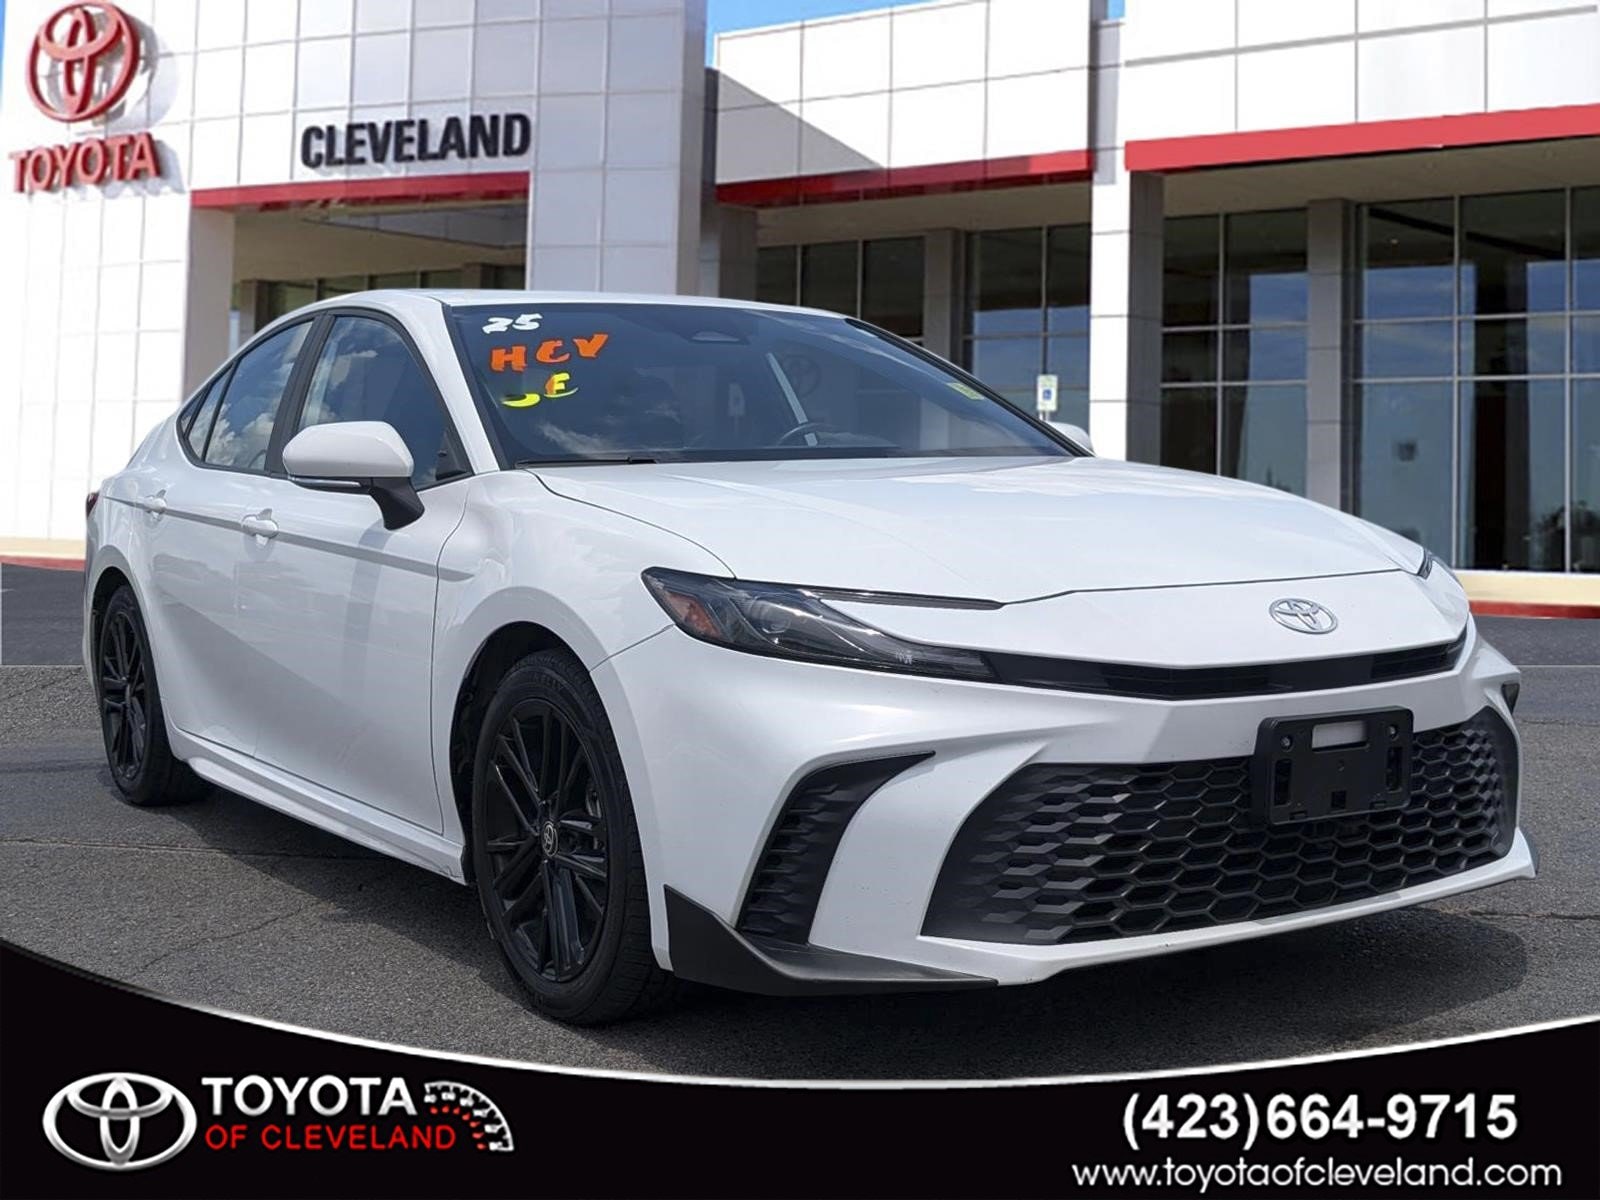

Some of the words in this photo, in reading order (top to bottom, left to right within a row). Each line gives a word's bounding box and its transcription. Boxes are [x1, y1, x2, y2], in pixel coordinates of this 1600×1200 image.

[9, 132, 161, 193] TOYOTA
[301, 112, 532, 169] CLEVELAND
[481, 313, 543, 335] 25
